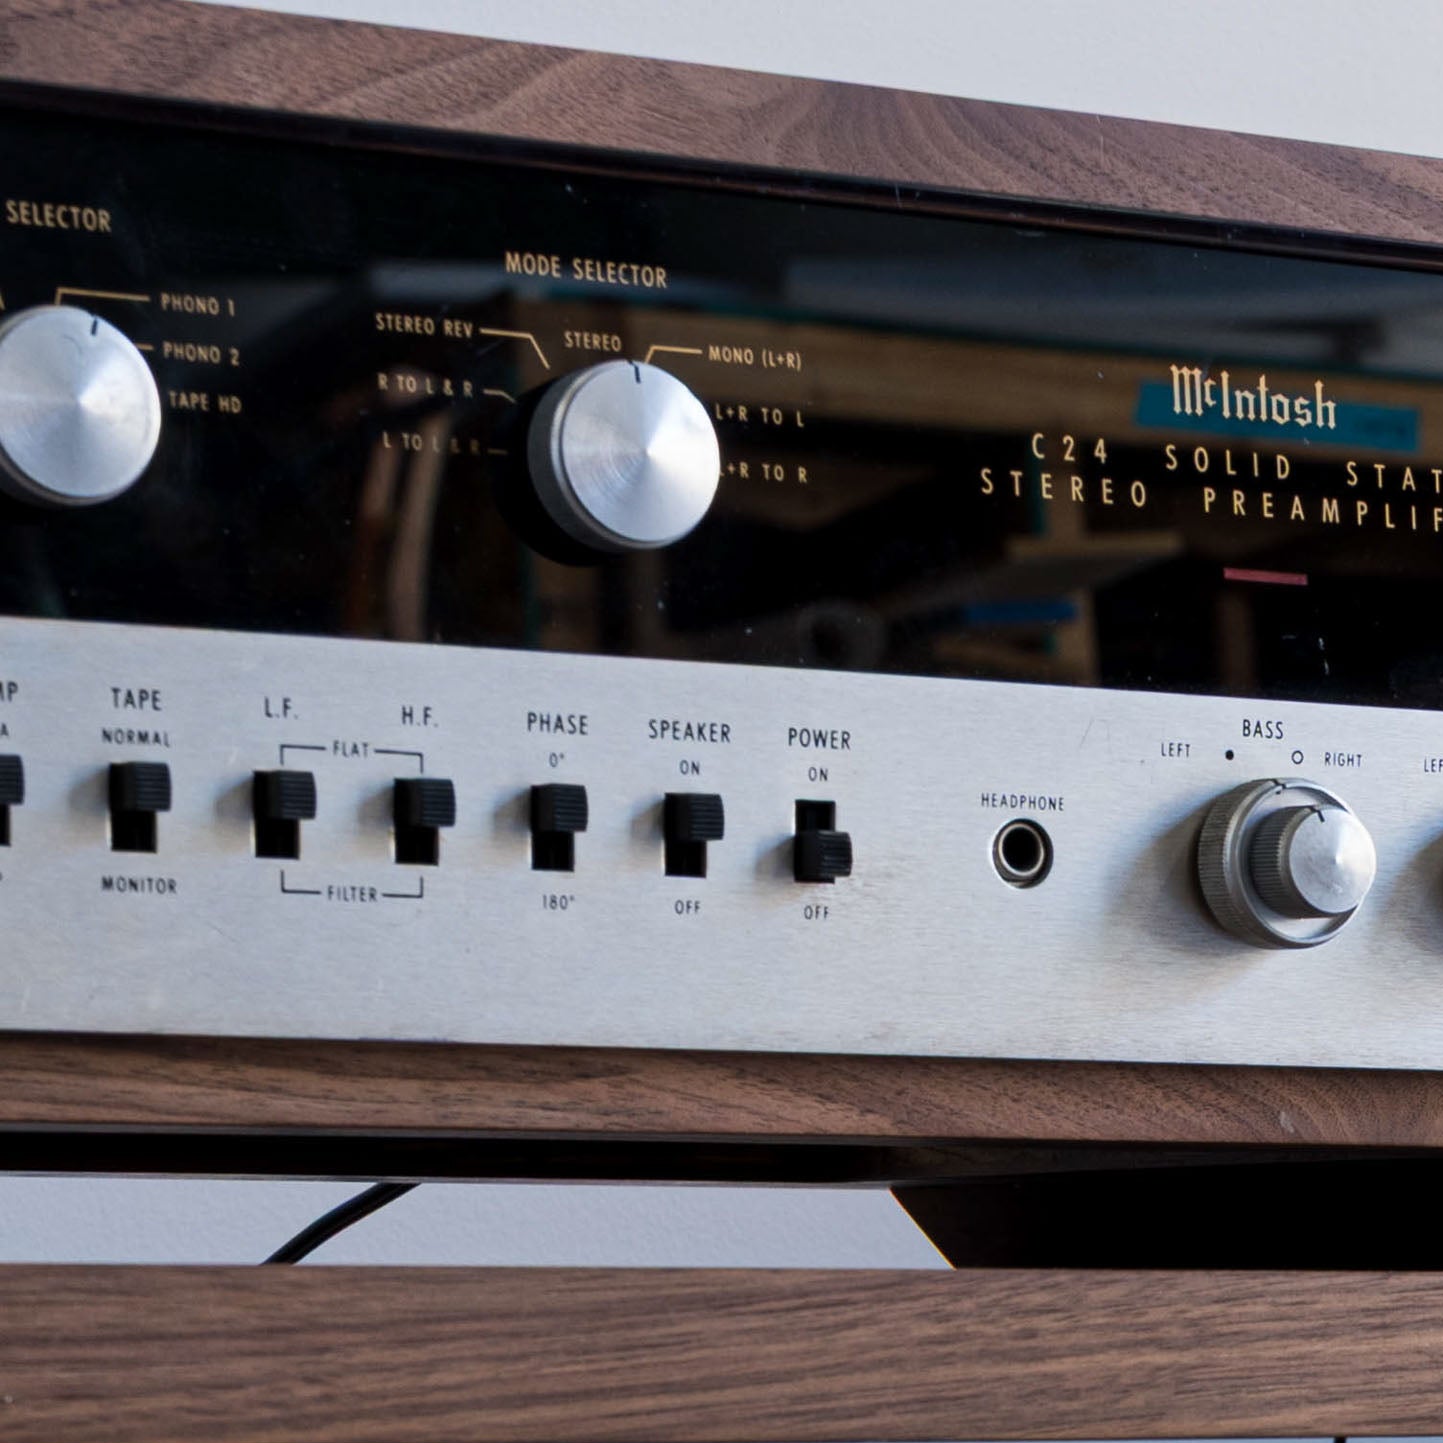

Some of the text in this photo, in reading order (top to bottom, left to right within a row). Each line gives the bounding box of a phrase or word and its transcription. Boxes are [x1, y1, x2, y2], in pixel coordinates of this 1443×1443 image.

[6, 200, 112, 233] SELECTOR
[505, 251, 668, 289] MODE SELECTOR
[160, 292, 235, 317] PHONO 1
[375, 313, 474, 338] STEREO REV
[564, 331, 622, 352] STEREO
[162, 341, 240, 367] PHONO 2
[708, 345, 802, 371] MONO (L+R)
[397, 375, 416, 393] TO
[169, 390, 242, 414] TAPE HD
[1170, 363, 1337, 430] McIntosh
[715, 402, 805, 428] L+R TO L
[762, 463, 784, 482] TO
[1165, 444, 1291, 480] SOLID
[981, 467, 1147, 507] STEREO
[111, 687, 163, 711] TAPE
[264, 697, 298, 719] L.F.
[400, 706, 439, 728] H.F.
[527, 711, 589, 735] PHASE
[102, 728, 170, 747] NORMAL
[648, 719, 732, 743] SPEAKER
[787, 727, 852, 750] POWER
[1242, 719, 1285, 740] BASS
[332, 740, 370, 758] FLAT
[1161, 742, 1191, 758] LEFT
[1324, 752, 1363, 768] RIGHT
[679, 760, 701, 776] ON
[808, 766, 829, 783] ON
[981, 793, 1065, 811] HEADPHONE
[102, 876, 178, 894] MONITOR
[326, 886, 379, 902] FILTER
[674, 900, 701, 915] OFF
[803, 906, 830, 921] OFF
